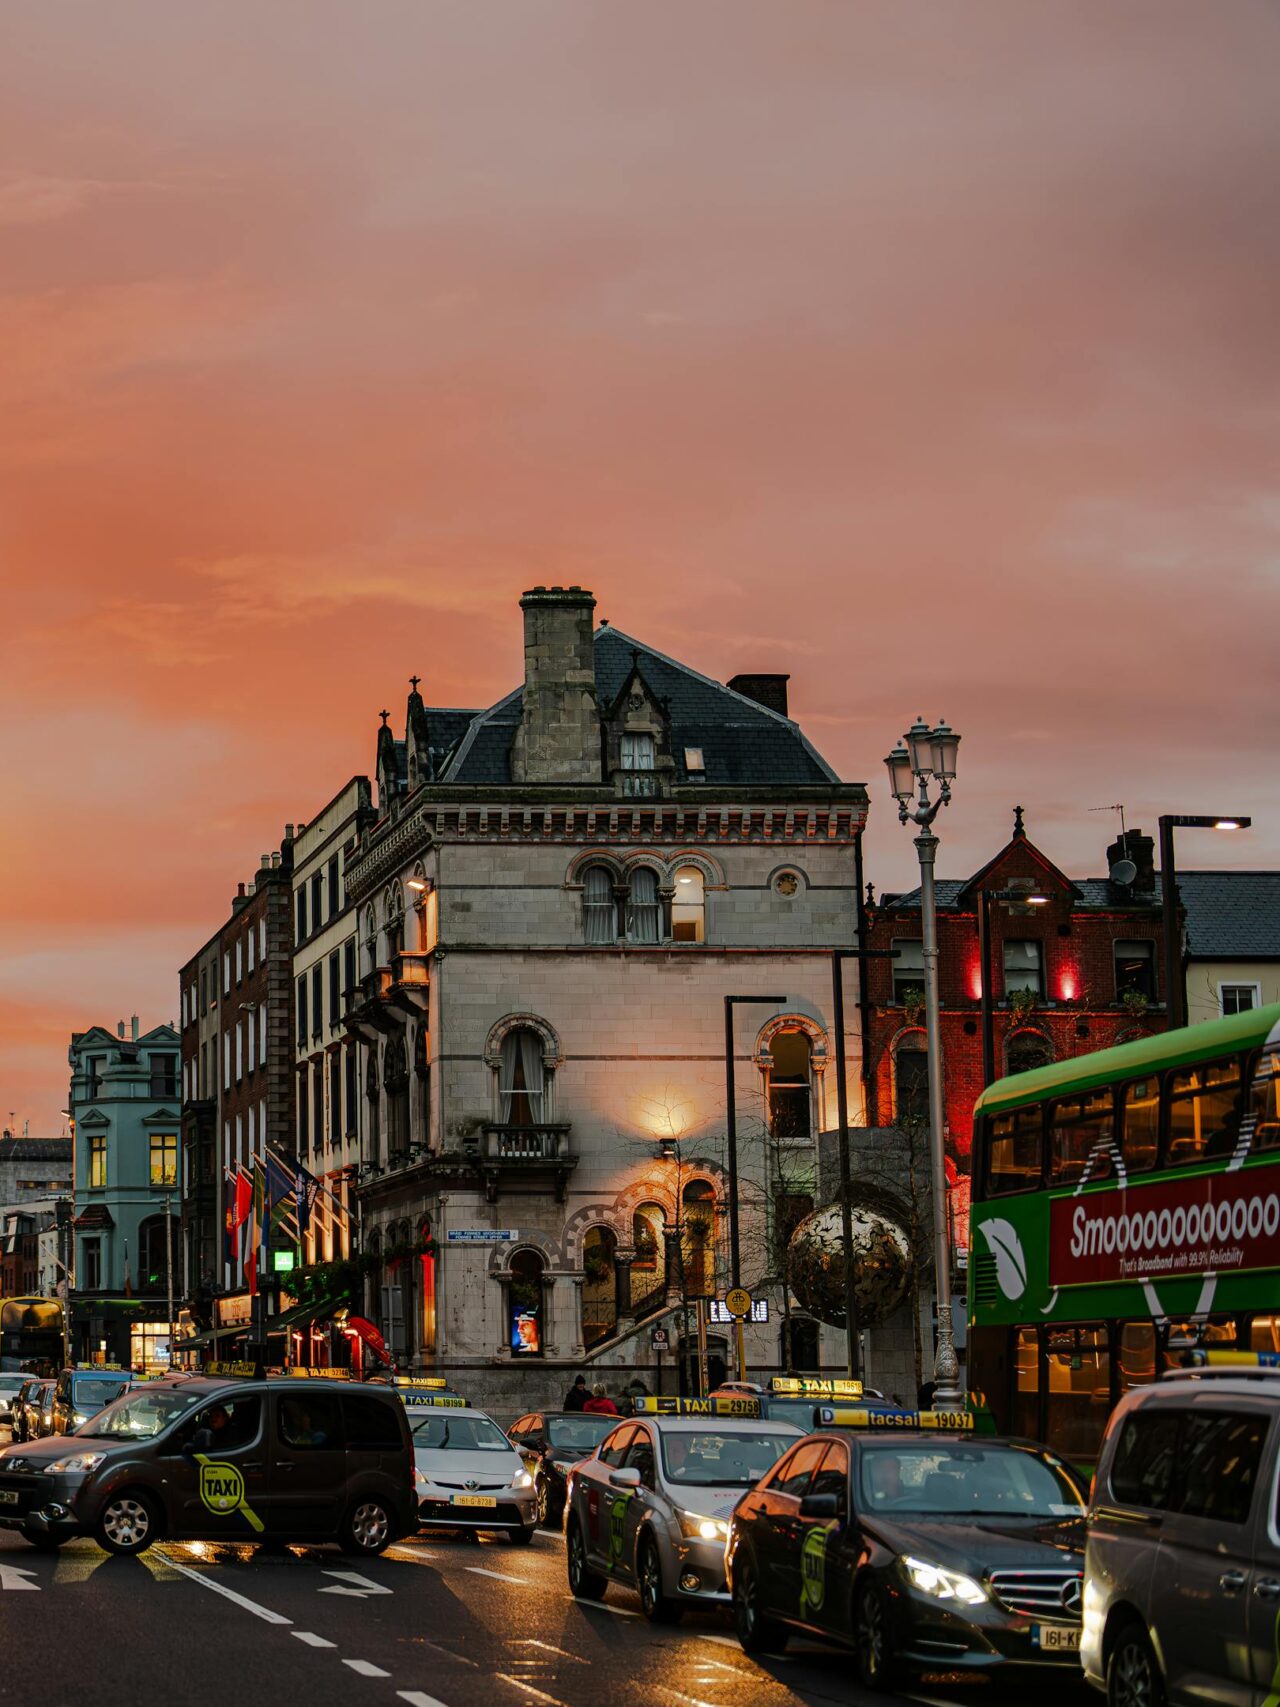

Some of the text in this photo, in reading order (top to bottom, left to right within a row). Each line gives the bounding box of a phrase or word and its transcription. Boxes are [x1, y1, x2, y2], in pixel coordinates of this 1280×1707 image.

[1138, 1252, 1174, 1271] Broadband
[1174, 1252, 1188, 1268] with
[1209, 1246, 1245, 1267] Reliability
[309, 1367, 327, 1377] TAXI
[804, 1380, 832, 1391] TAXI
[408, 1396, 432, 1406] TAXI
[683, 1399, 712, 1412] TAXI
[730, 1400, 759, 1413] 29758
[822, 1409, 970, 1428] D tacsai 19037
[206, 1480, 237, 1496] TAXI
